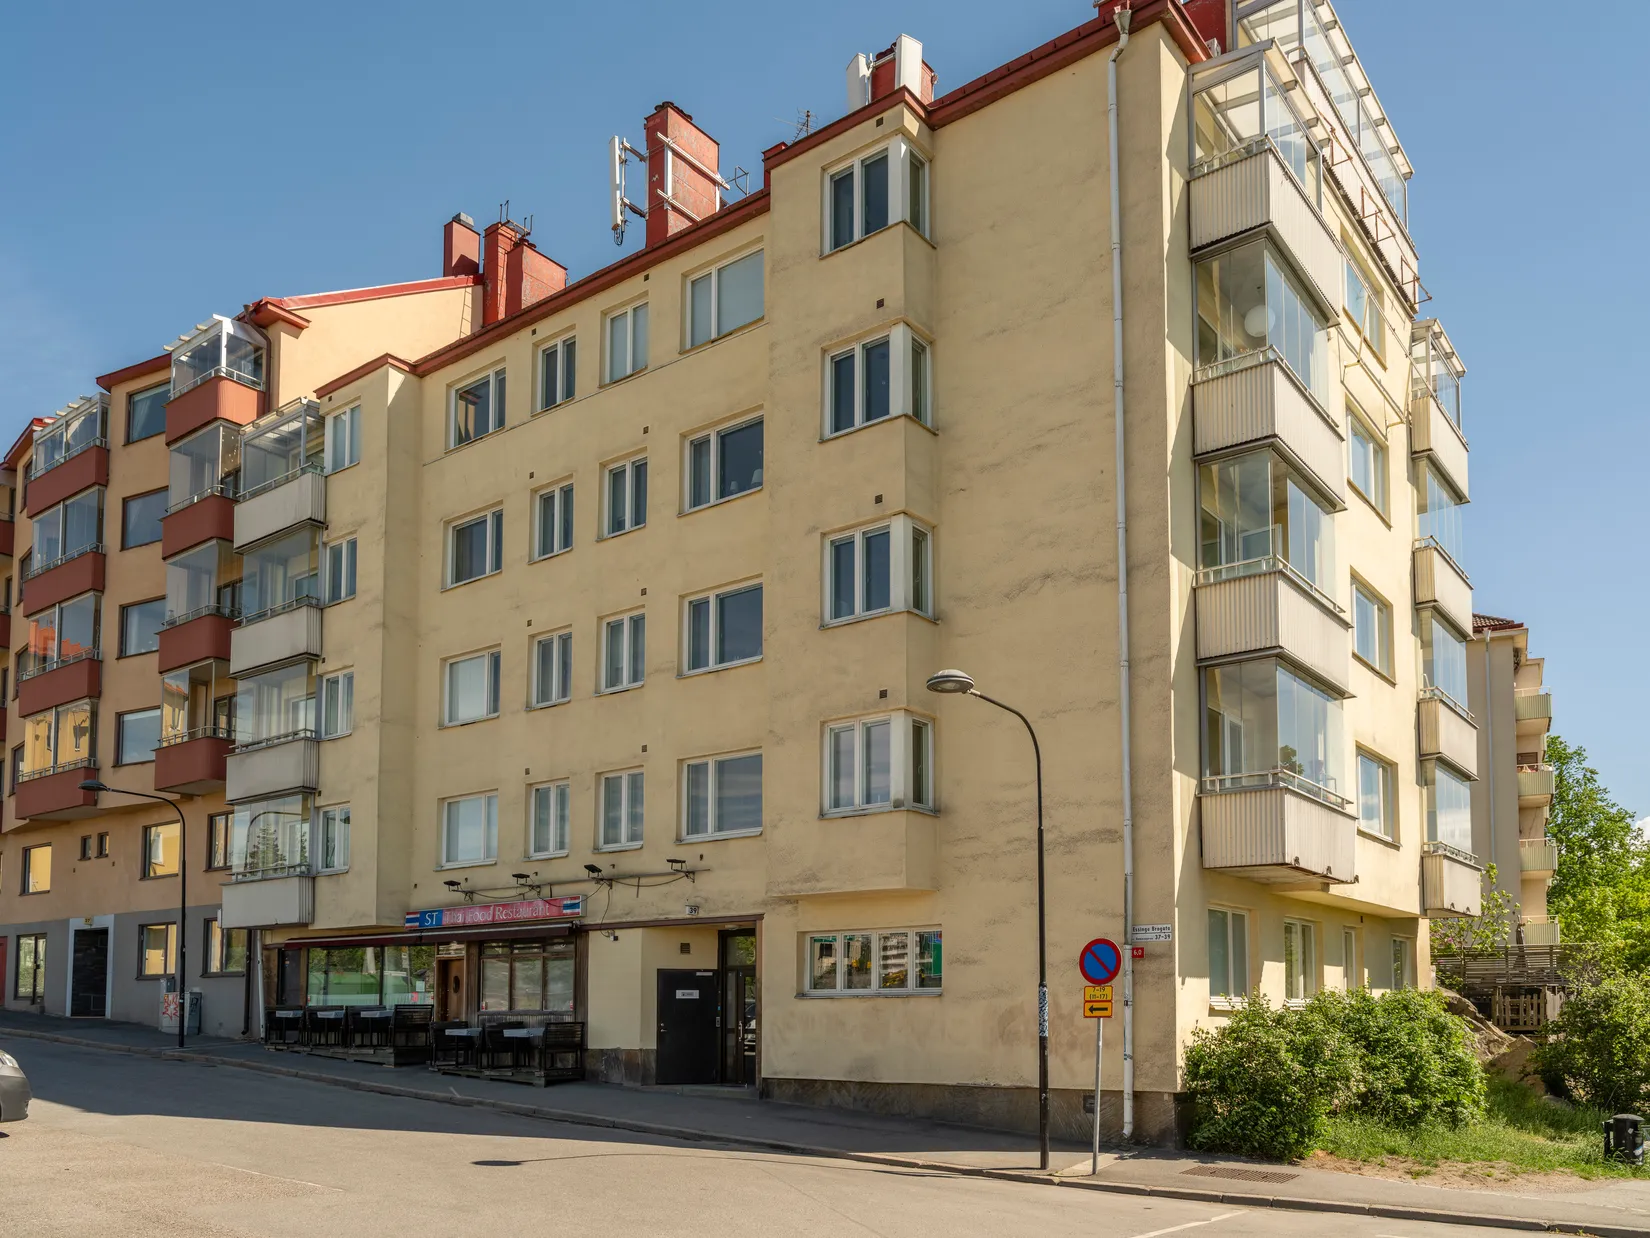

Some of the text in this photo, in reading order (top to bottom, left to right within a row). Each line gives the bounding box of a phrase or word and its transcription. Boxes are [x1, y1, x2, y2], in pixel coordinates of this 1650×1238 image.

[424, 904, 550, 926] ST Thai Food Restaurant
